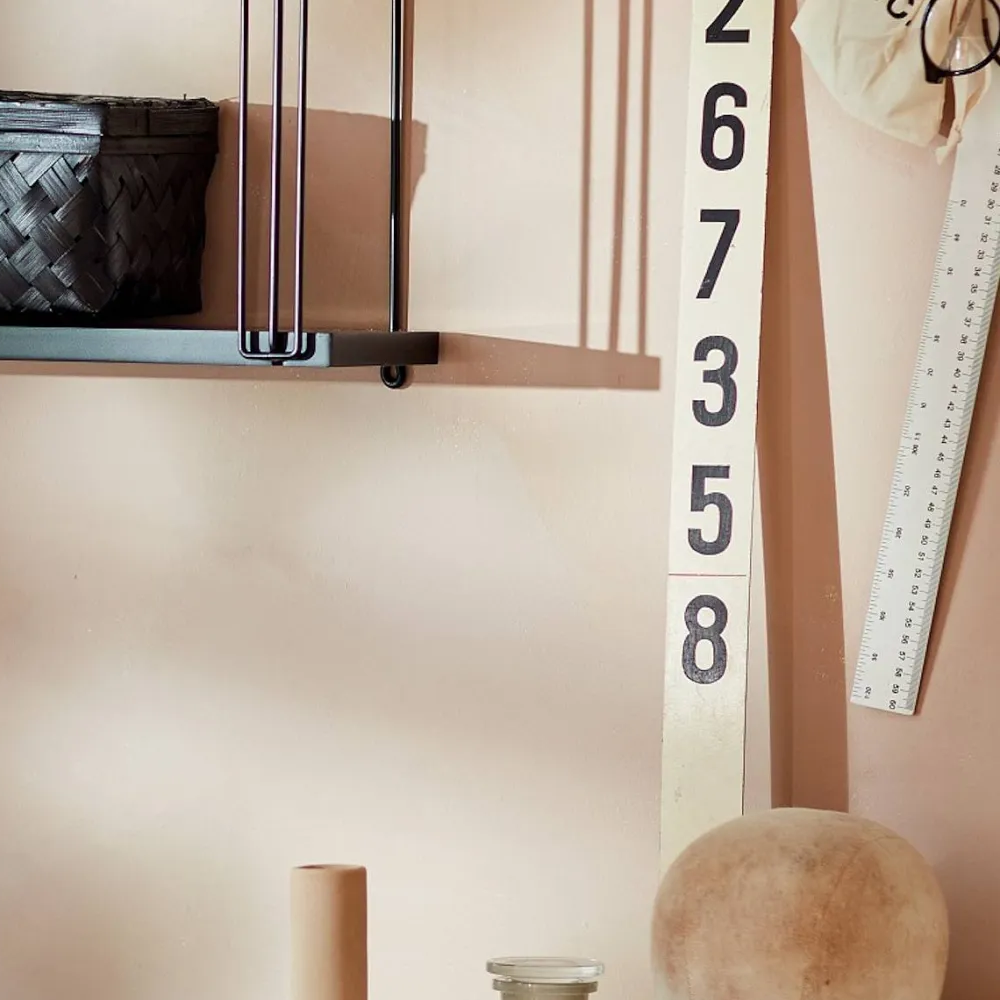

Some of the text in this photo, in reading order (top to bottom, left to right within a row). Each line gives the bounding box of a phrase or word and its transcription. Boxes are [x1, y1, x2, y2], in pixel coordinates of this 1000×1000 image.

[701, 83, 747, 171] 6
[696, 209, 740, 298] 7
[693, 336, 737, 426] 3
[688, 465, 732, 555] 5
[683, 595, 727, 684] 8
